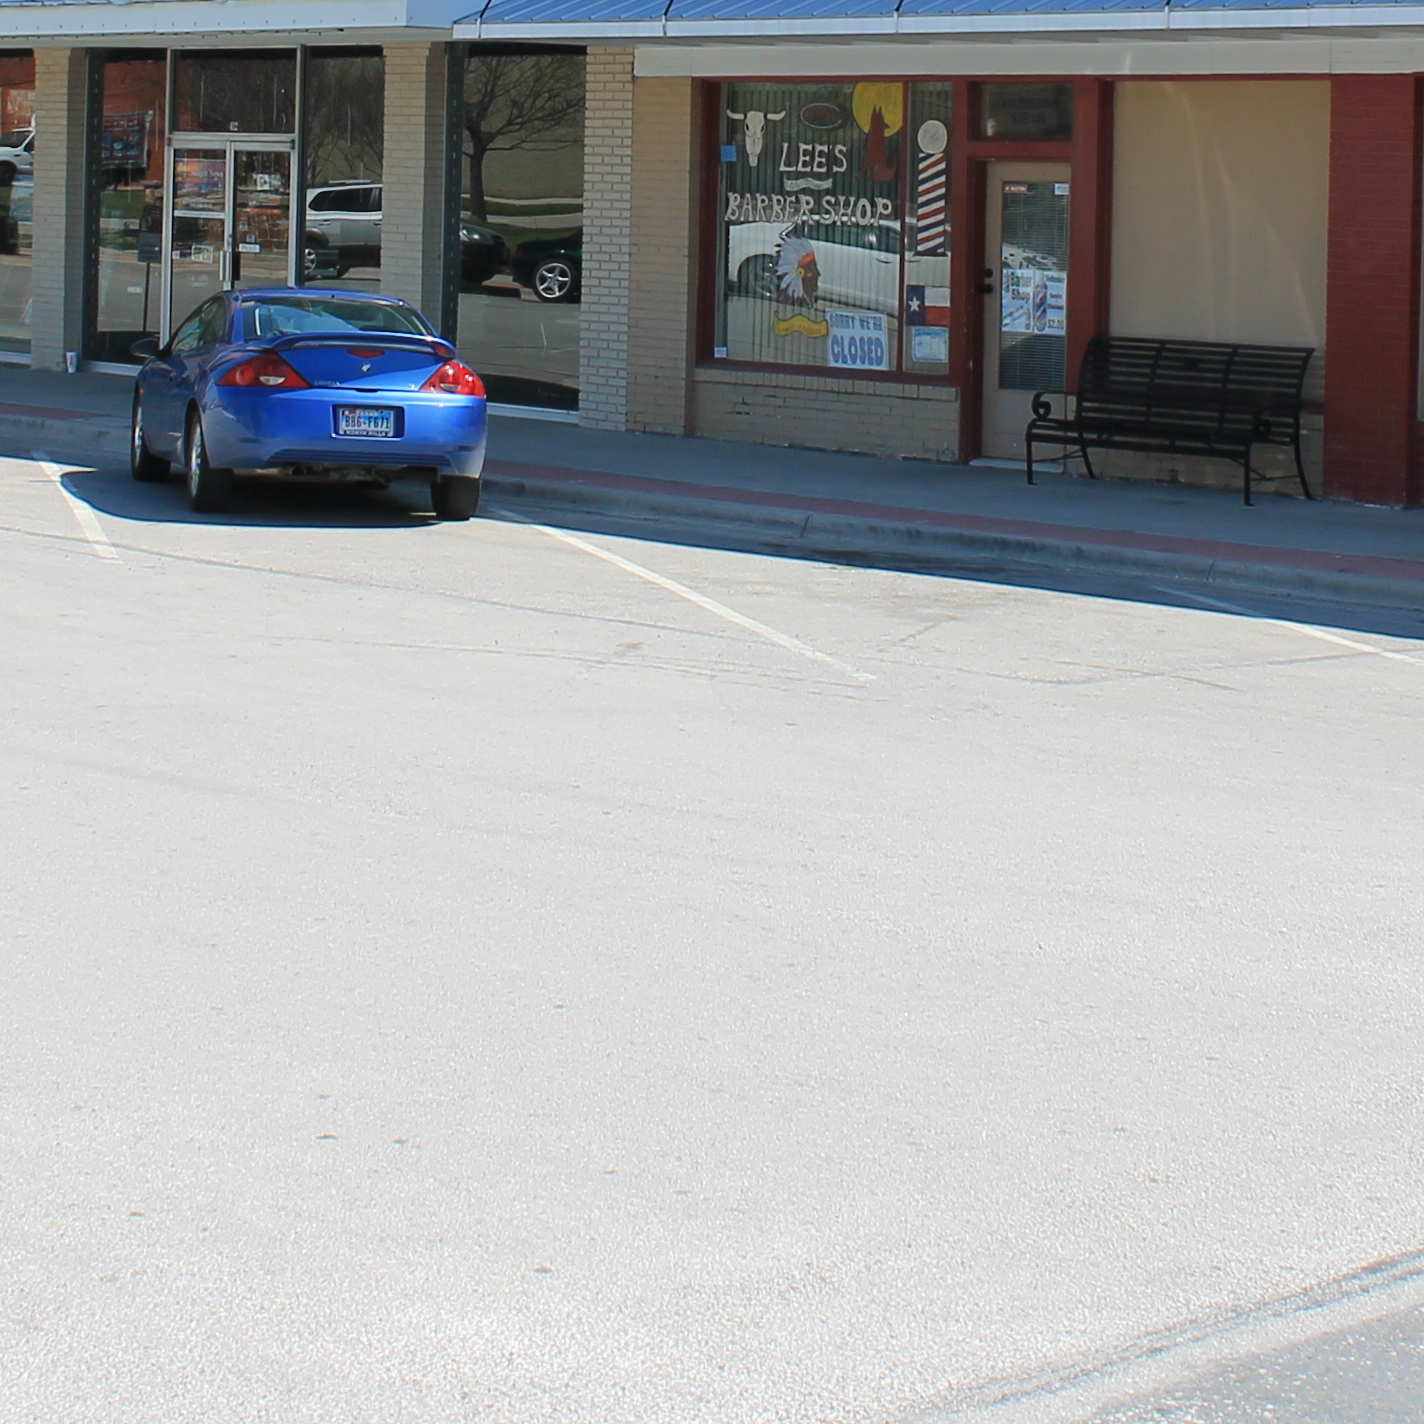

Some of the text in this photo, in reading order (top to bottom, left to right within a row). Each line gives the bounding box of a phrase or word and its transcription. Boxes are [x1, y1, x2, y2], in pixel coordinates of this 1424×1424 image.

[779, 142, 847, 173] LEE'S
[724, 192, 892, 227] BARBER SHOP
[829, 313, 855, 329] SORRY
[831, 334, 884, 366] CLOSED
